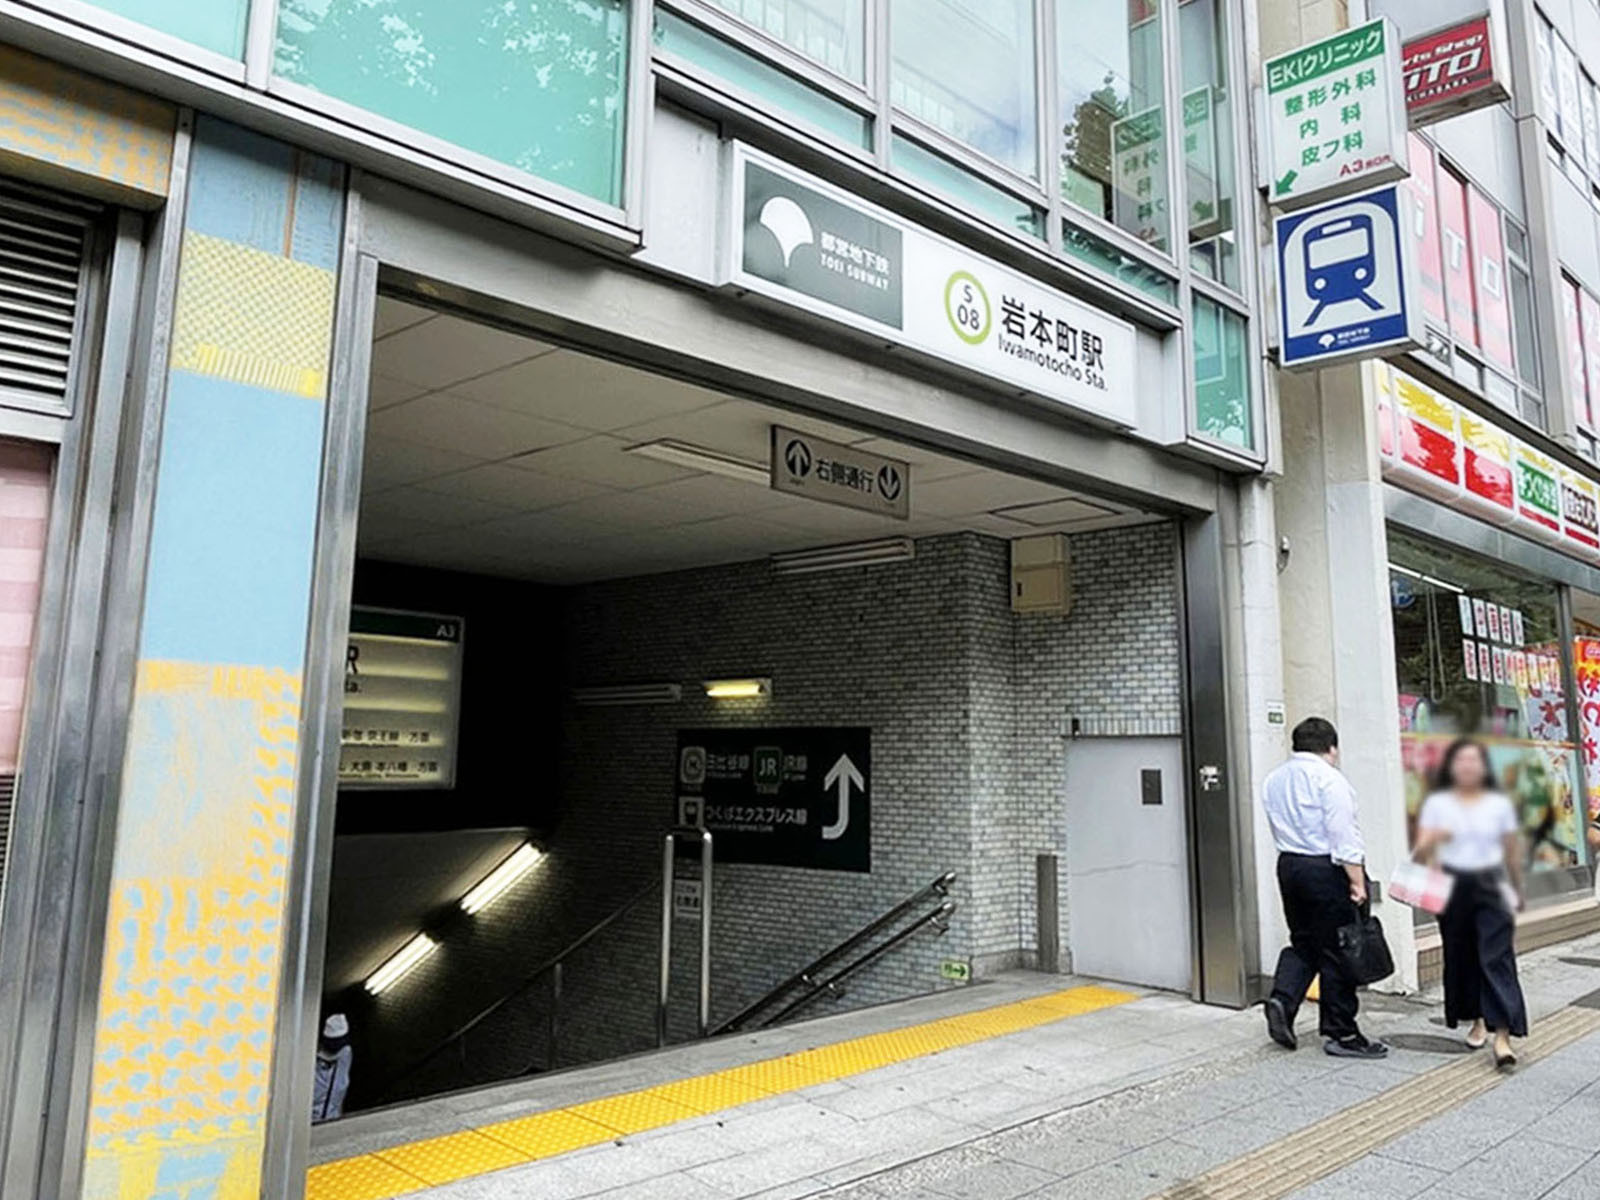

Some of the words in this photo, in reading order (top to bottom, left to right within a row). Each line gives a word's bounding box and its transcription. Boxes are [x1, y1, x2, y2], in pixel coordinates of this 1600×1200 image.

[1270, 30, 1382, 88] EKIクリニック
[1285, 68, 1376, 116] 整形外科
[1407, 77, 1469, 101] KIHABARA
[1302, 131, 1363, 167] 皮フ科
[821, 253, 844, 273] TOEI
[847, 264, 889, 290] SUBWAY
[963, 285, 973, 304] S
[957, 304, 980, 330] 08
[1001, 295, 1104, 371] 岩本町駅
[998, 333, 1082, 381] Iwamotocho
[1085, 369, 1109, 392] Sta.
[816, 459, 875, 493] 右側通行
[759, 757, 777, 776] JR
[705, 806, 808, 825] つくばエクスプレス線
